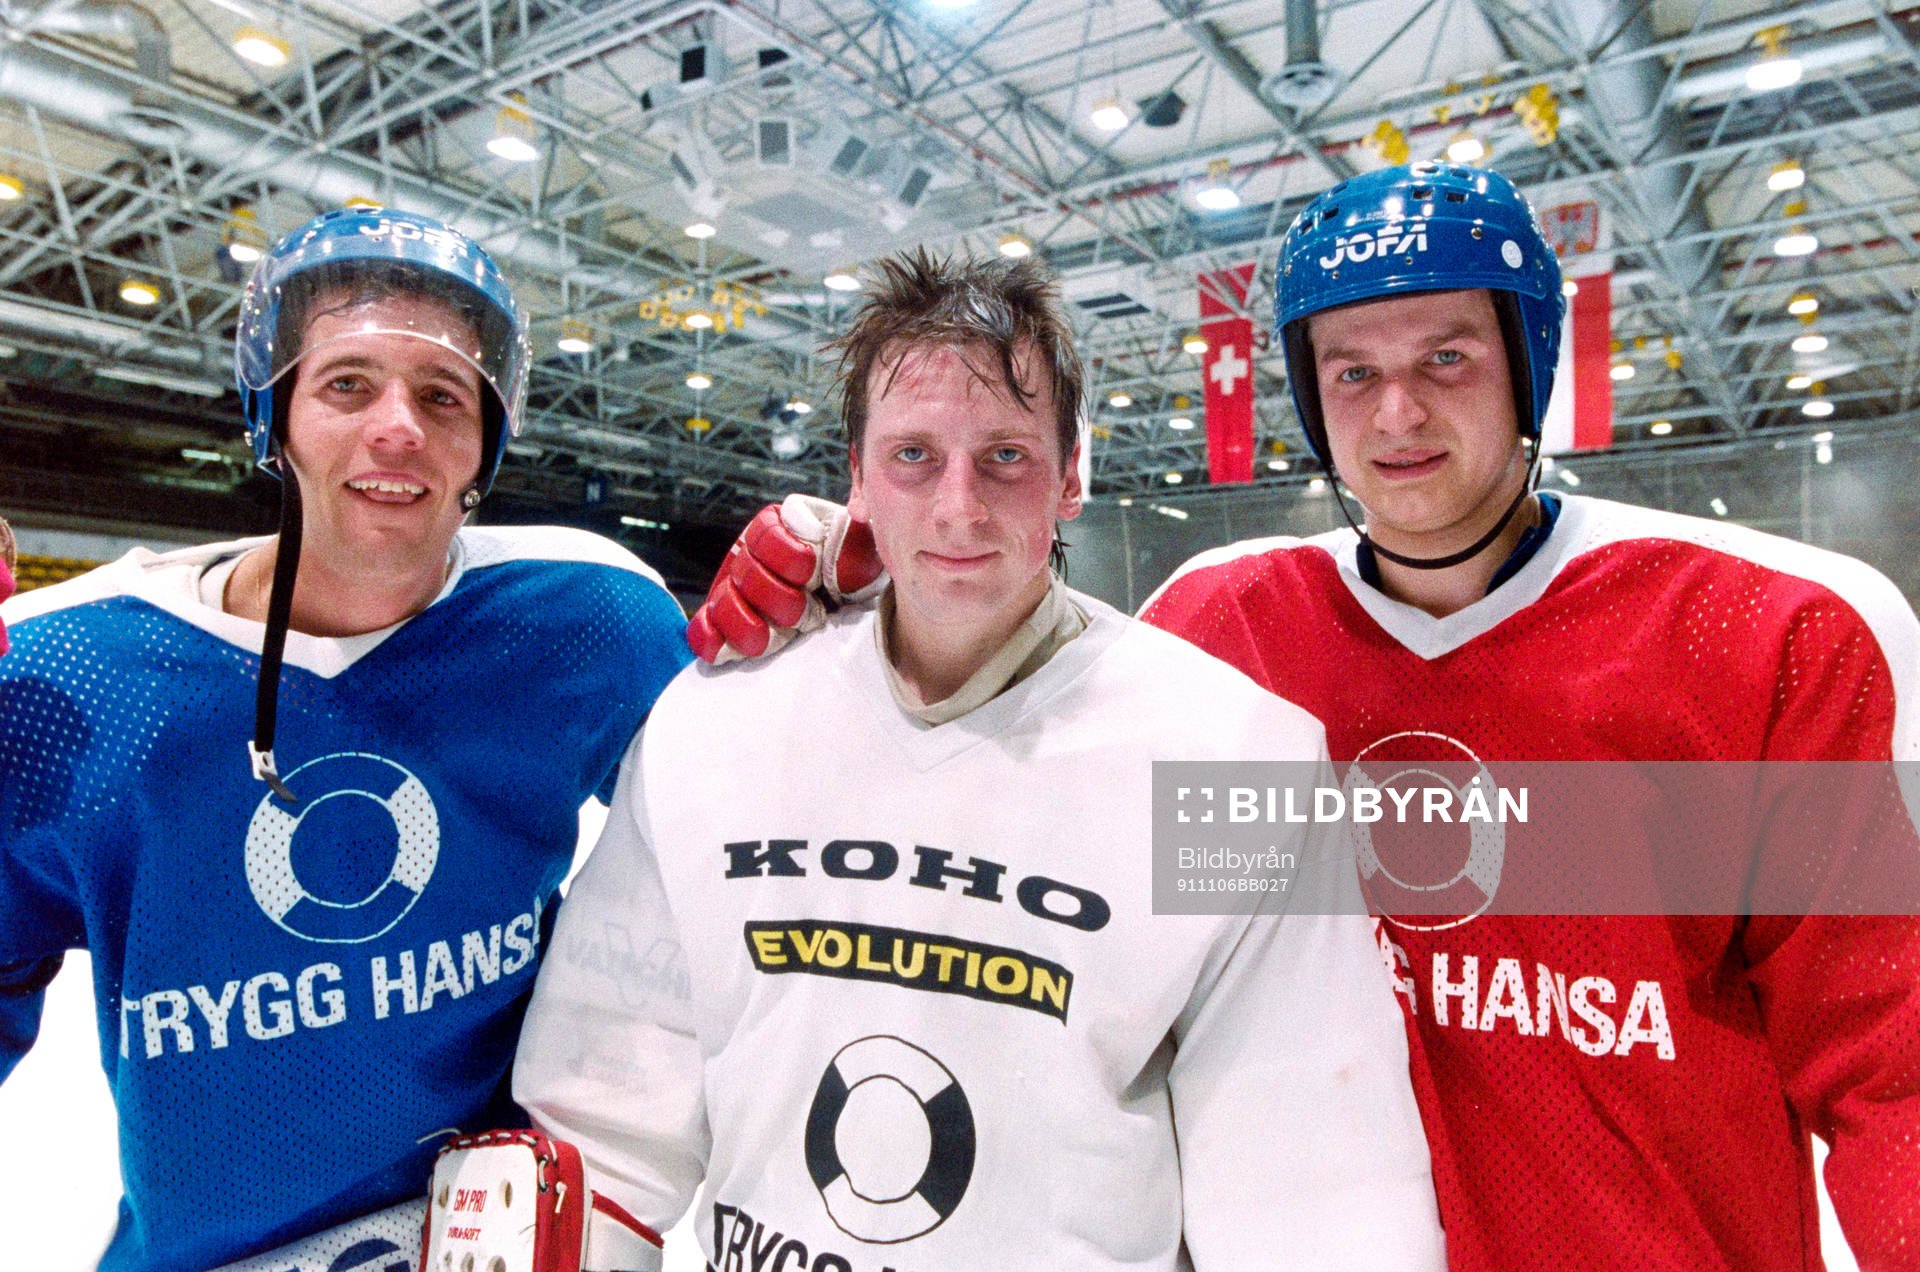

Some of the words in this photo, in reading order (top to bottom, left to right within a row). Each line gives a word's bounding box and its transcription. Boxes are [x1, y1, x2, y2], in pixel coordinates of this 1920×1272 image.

[1319, 223, 1427, 270] JOFA
[724, 839, 1111, 932] KOHO
[752, 929, 1067, 1011] EVOLUTION
[1432, 952, 1676, 1061] HANSA
[467, 1189, 487, 1213] PRO
